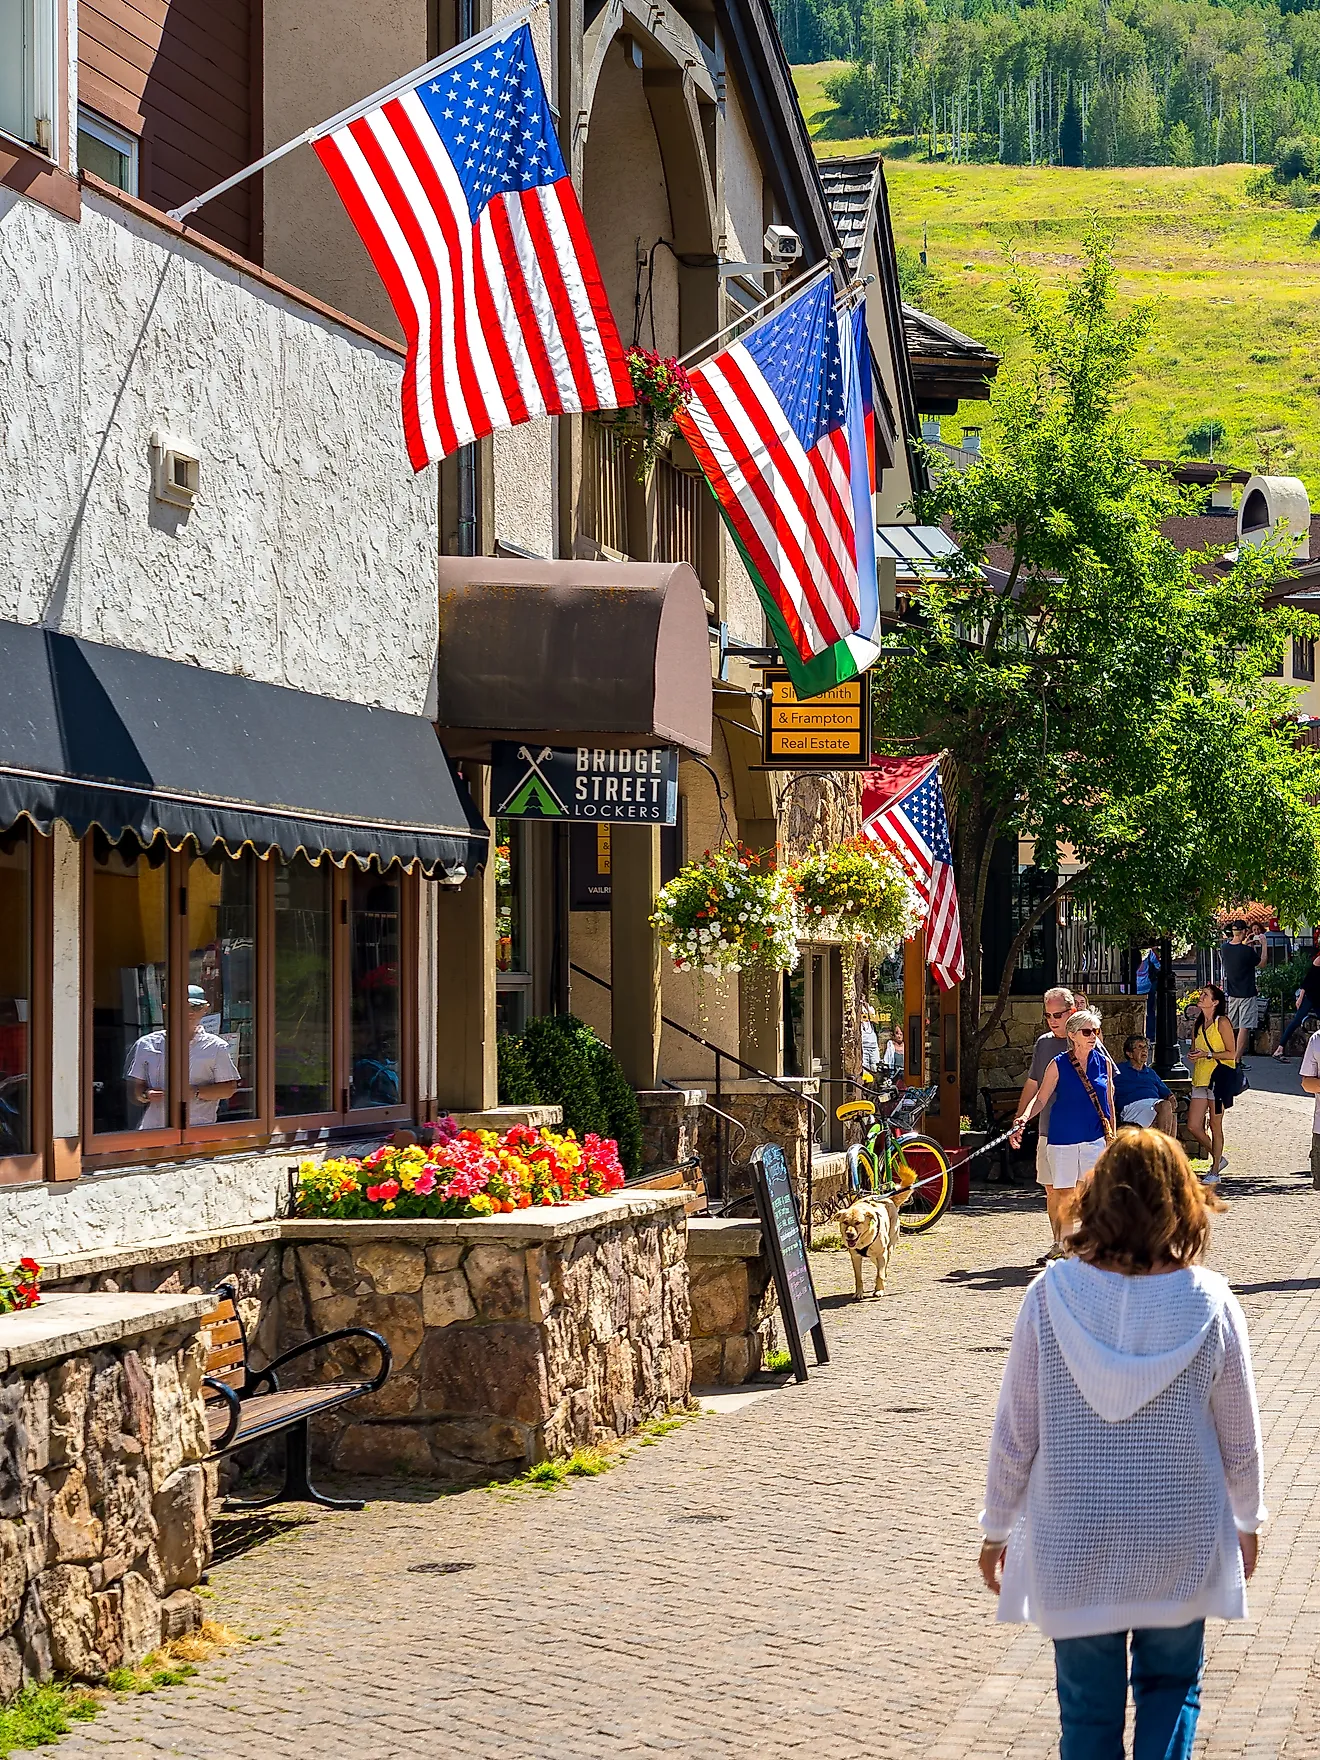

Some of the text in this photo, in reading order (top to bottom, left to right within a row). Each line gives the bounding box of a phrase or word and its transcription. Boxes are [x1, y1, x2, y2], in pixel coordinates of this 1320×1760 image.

[778, 712, 853, 727] & Frampton
[781, 737, 850, 749] Real Estate
[576, 747, 662, 774] BRIDGE
[575, 776, 662, 803] STREET
[575, 804, 661, 819] LOCKERS
